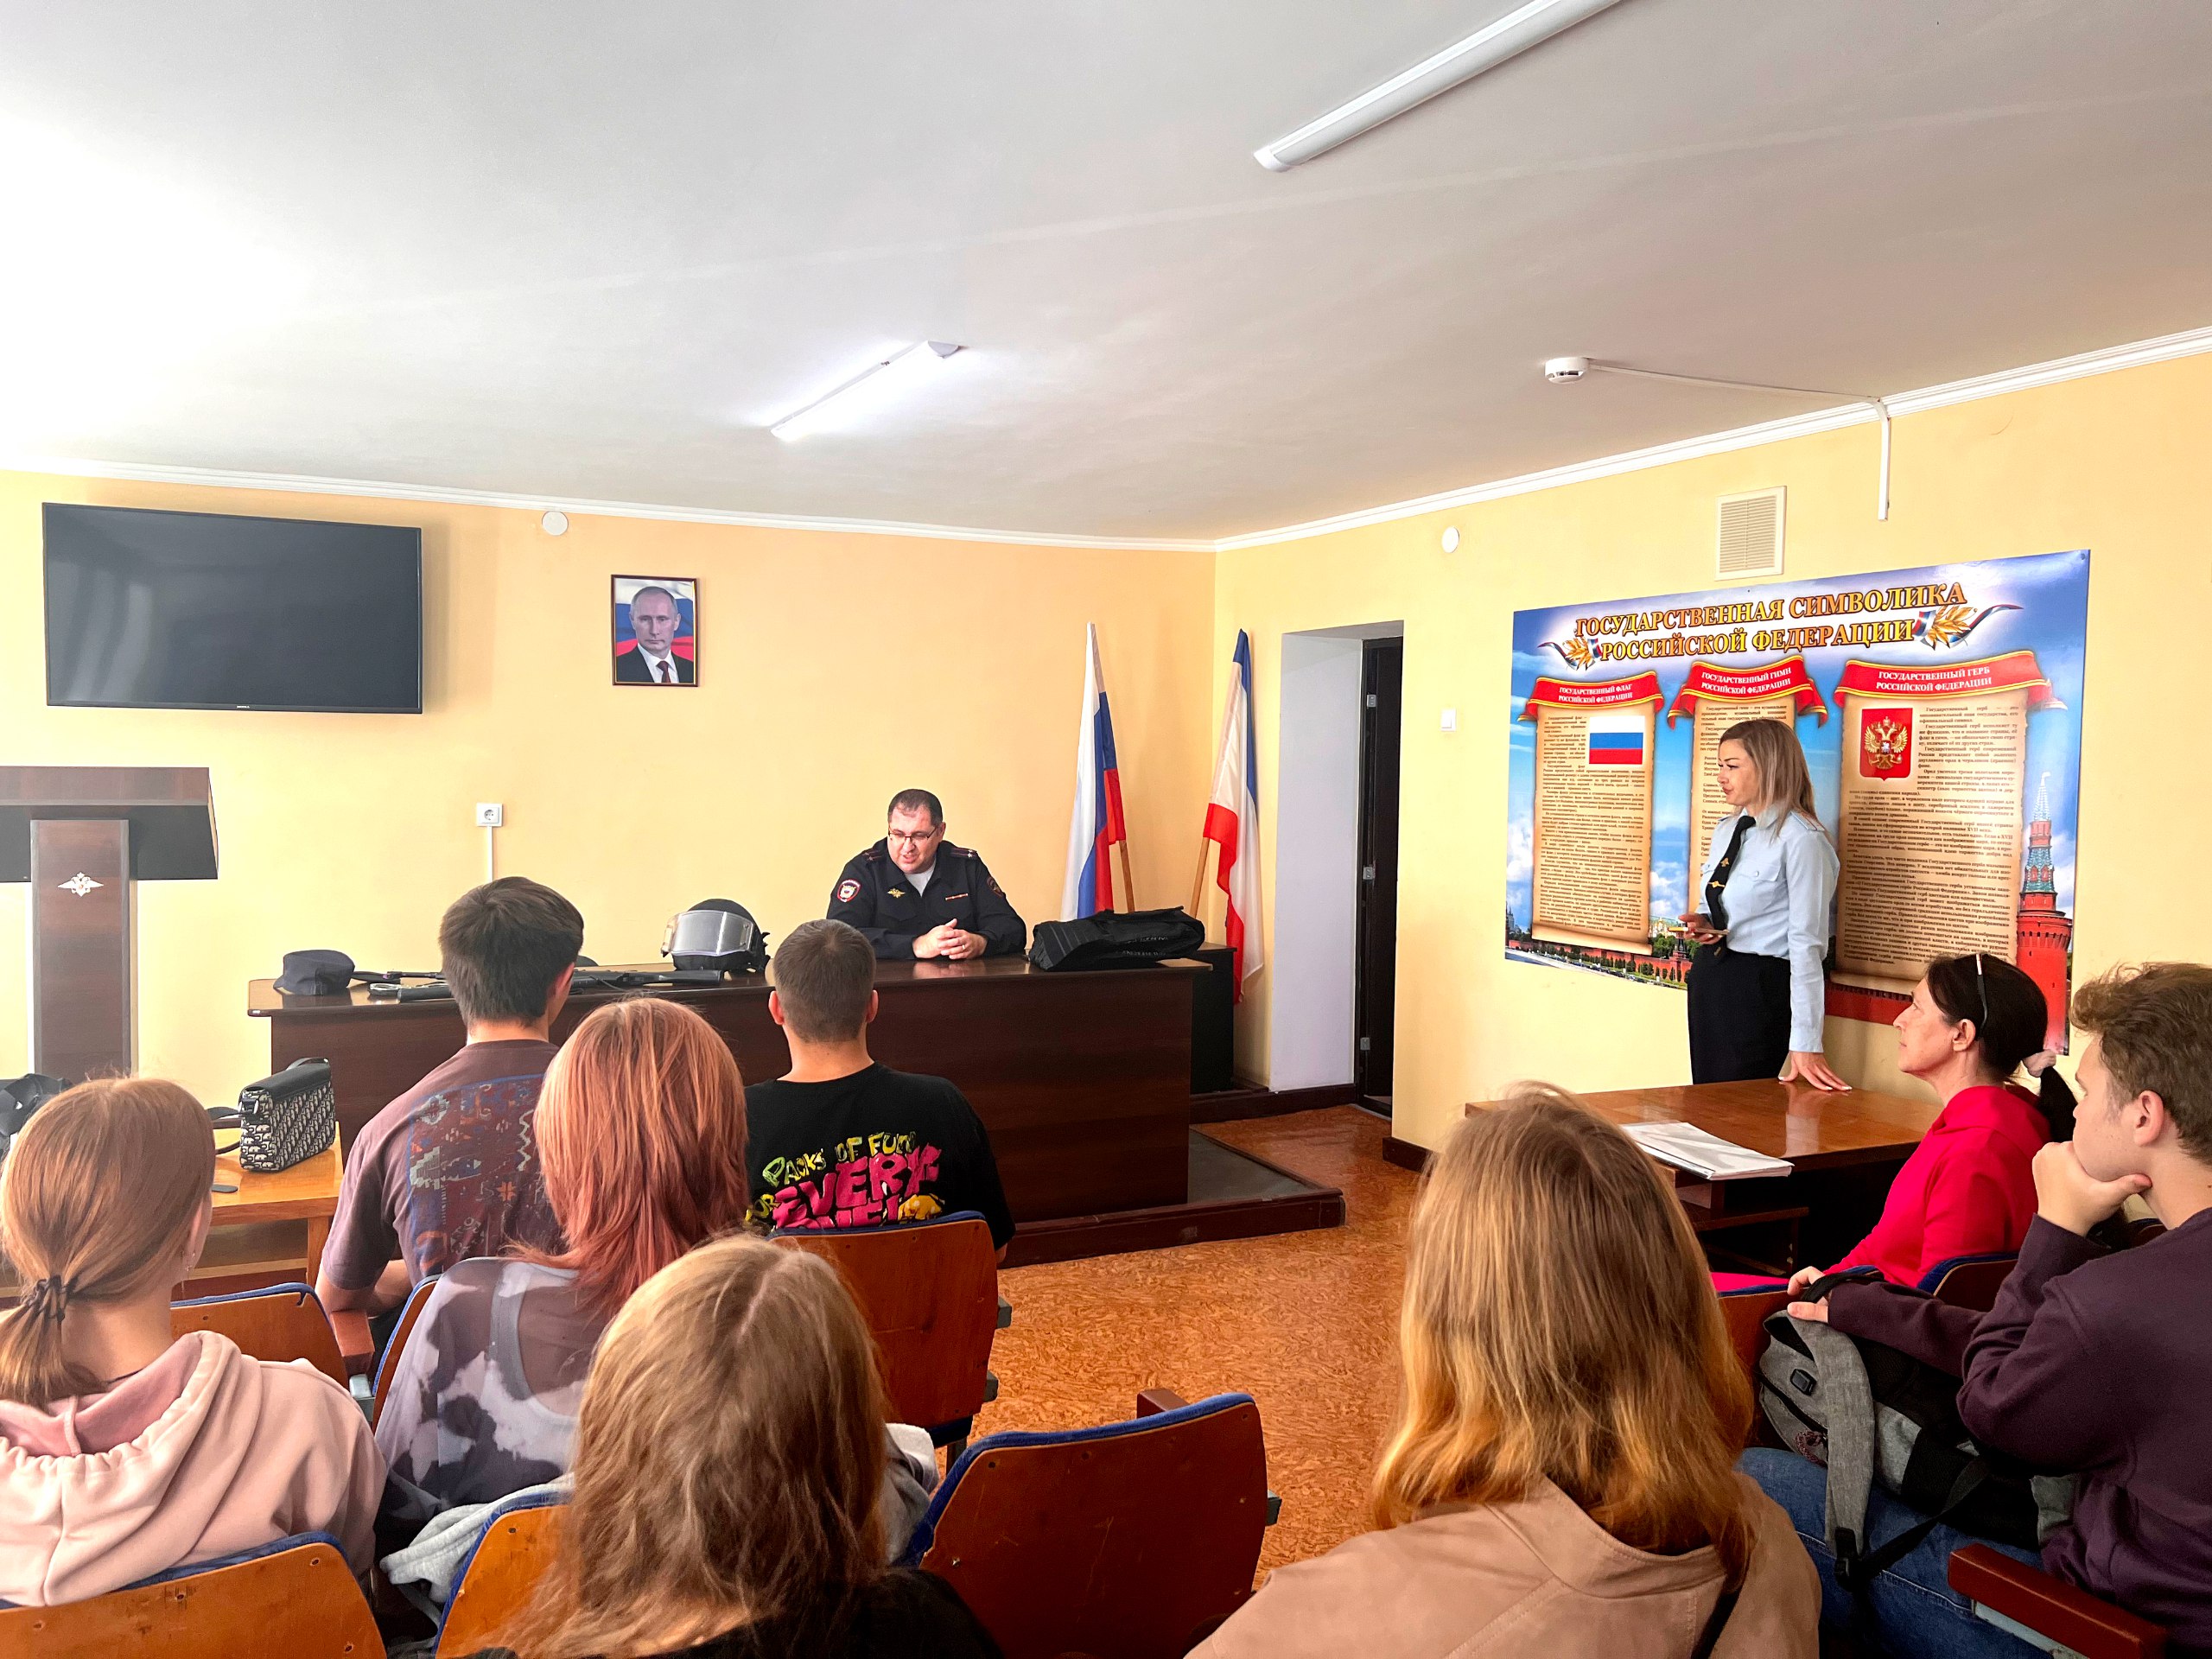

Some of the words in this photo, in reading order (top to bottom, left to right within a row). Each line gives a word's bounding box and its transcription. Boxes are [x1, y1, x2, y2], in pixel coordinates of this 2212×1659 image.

[1576, 600, 1784, 637] ГОСУДАРСТВЕННАЯ
[1789, 582, 1967, 619] СИМВОЛИКА
[1600, 627, 1747, 661] РОССИЙСКОЙ
[1751, 620, 1915, 653] ФЕДЕРАЦИИ
[1701, 672, 1769, 683] ГОСУДАРСТВЕННЫЙ
[1770, 667, 1791, 679] ГИМН
[1878, 669, 1966, 681] ГОСУДАРСТВЕННЫЙ
[1967, 666, 1990, 677] ГЕРБ
[1559, 685, 1615, 695] ГОСУДАРСТВЕННЫЙ
[1616, 683, 1632, 692] ФЛАГ
[1701, 682, 1746, 694] РОССИЙСКОЙ
[1746, 678, 1791, 694] ФЕДЕРАЦИИ
[1876, 682, 1934, 691] РОССИЙСКОЙ
[1935, 677, 1992, 690] ФЕДЕРАЦИИ
[1558, 695, 1595, 703] РОССИЙСКОЙ
[1596, 692, 1633, 702] ФЕДЕРАЦИИ
[835, 1136, 862, 1162] OF
[772, 1142, 942, 1229] EVERY
